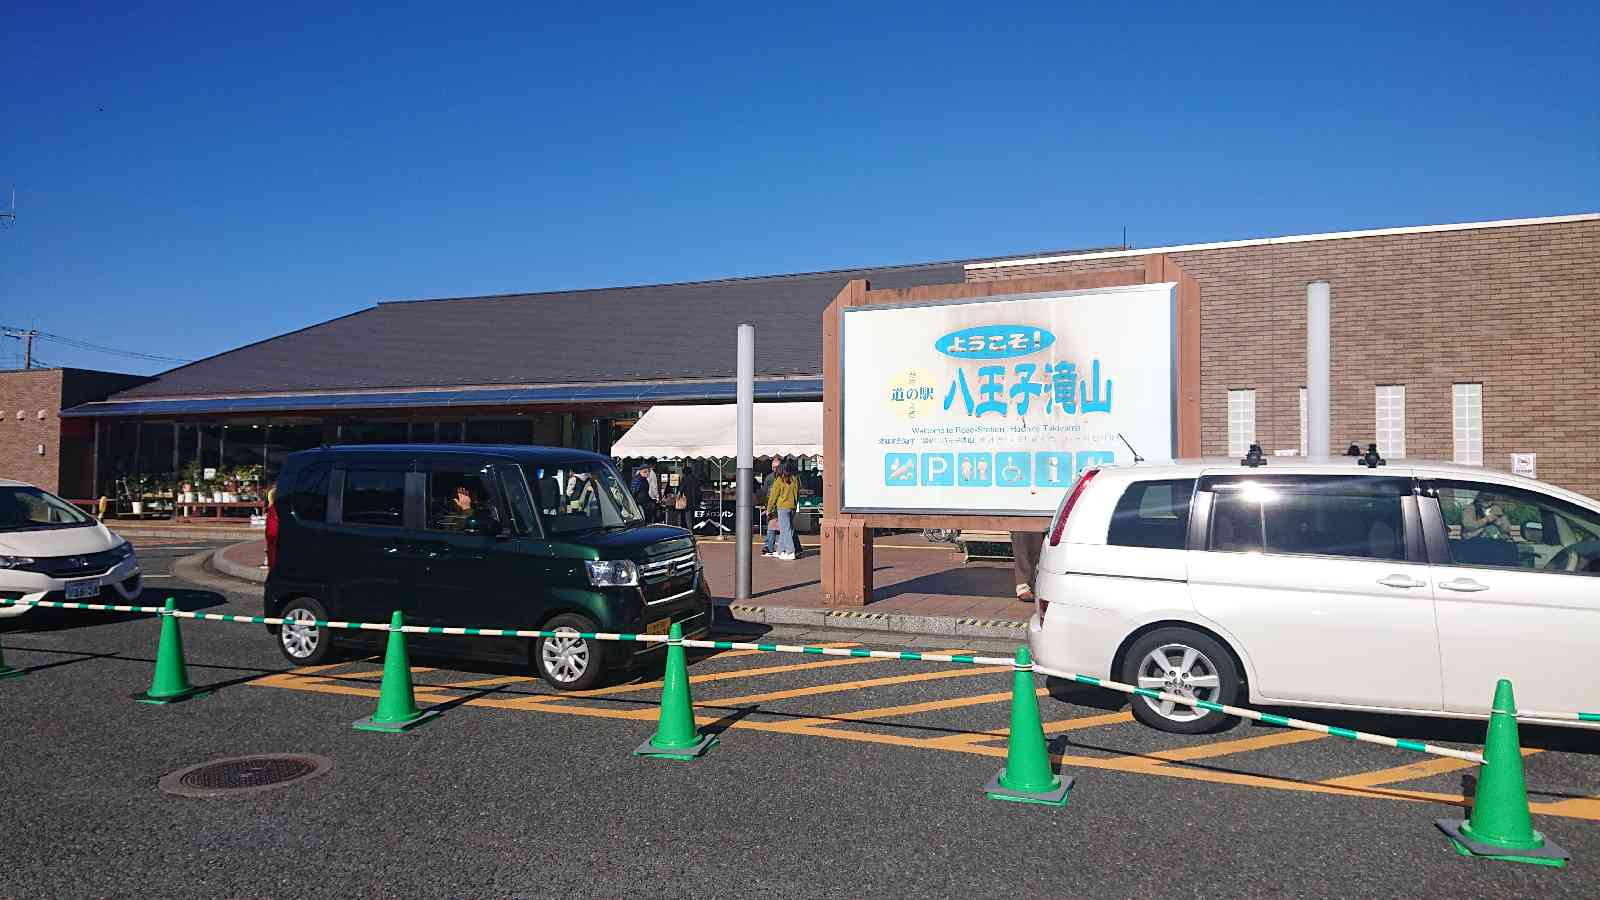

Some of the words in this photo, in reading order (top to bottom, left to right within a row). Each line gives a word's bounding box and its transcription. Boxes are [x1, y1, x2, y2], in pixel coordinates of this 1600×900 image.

[891, 386, 934, 402] 道の駅
[943, 359, 1113, 417] 八王子滝山
[928, 457, 947, 481] P
